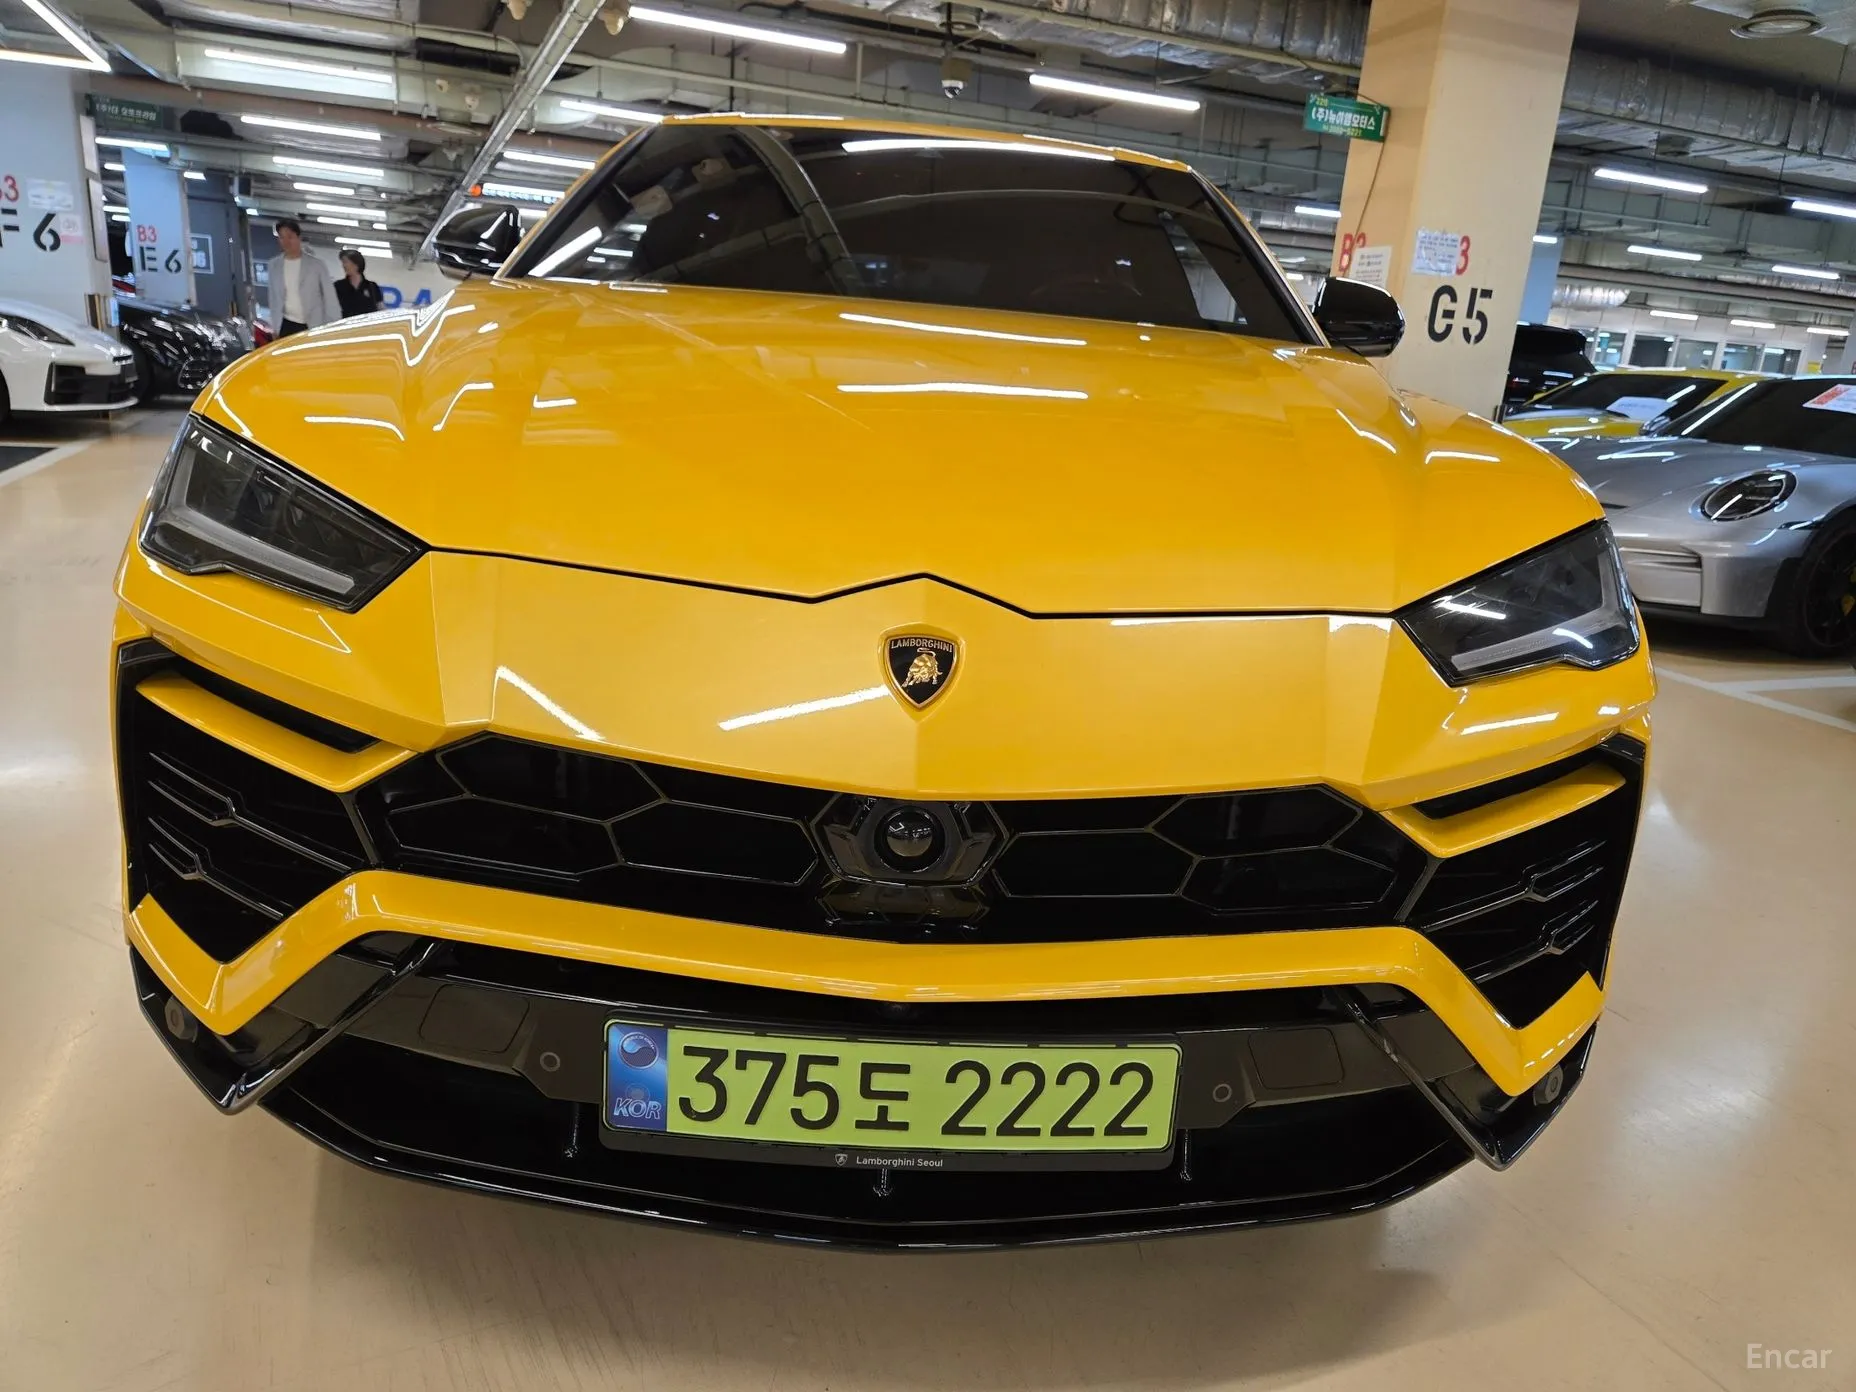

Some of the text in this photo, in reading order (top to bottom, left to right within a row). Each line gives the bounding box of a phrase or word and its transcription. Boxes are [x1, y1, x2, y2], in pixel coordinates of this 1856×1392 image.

[137, 225, 157, 242] B3
[890, 637, 953, 653] LAMBORGHINI
[678, 1045, 1154, 1137] 375도 2222
[613, 1097, 662, 1120] KOR
[856, 1156, 943, 1168] Lamborghini Seoul
